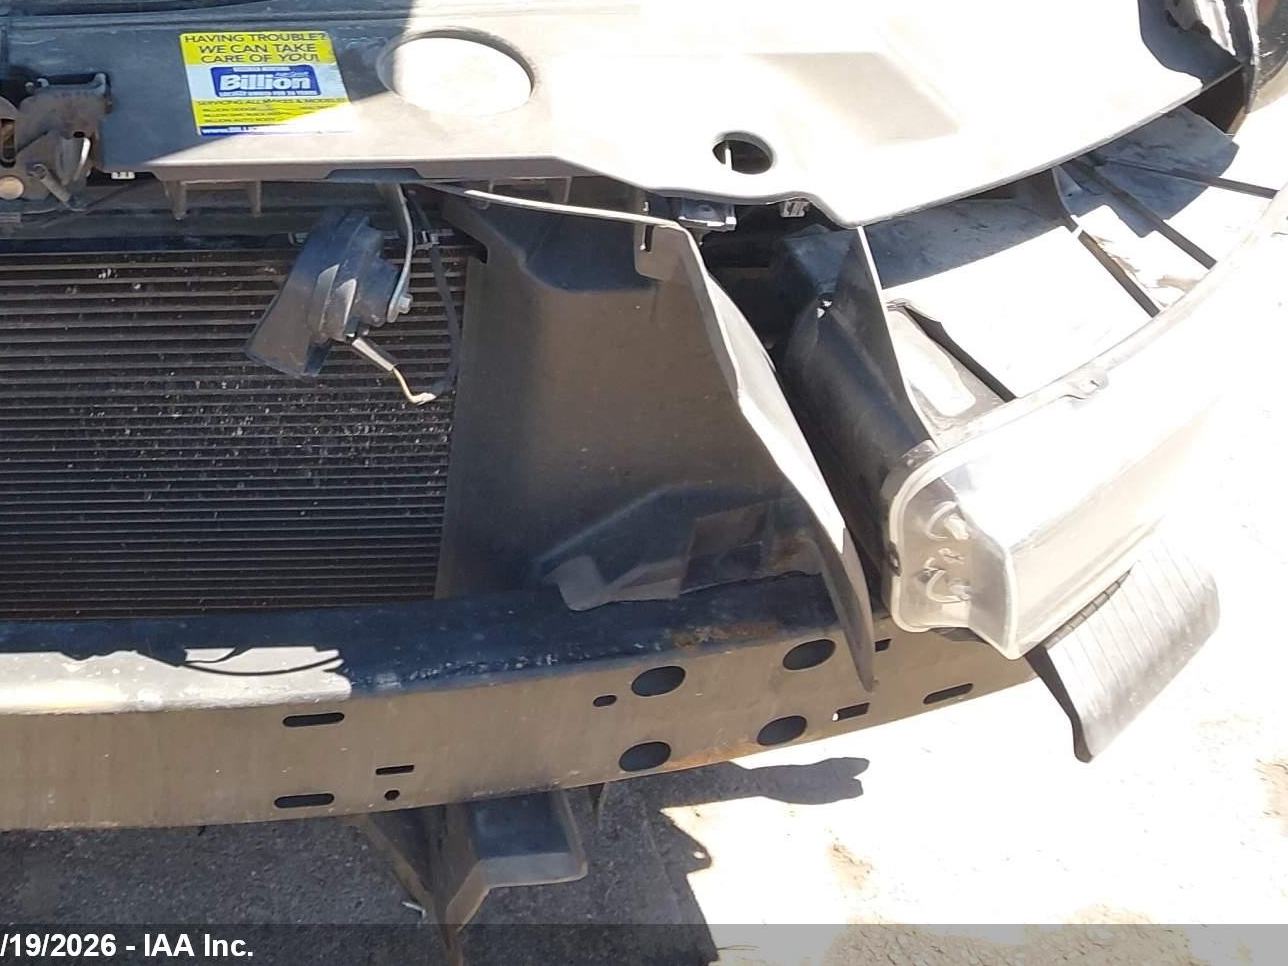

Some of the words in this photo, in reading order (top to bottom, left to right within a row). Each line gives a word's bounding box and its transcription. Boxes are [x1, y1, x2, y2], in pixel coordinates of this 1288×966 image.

[185, 34, 245, 43] HAVING
[249, 33, 327, 42] TROUBLE?
[199, 44, 225, 53] WE
[230, 44, 267, 53] CAN
[273, 43, 317, 52] TAKE
[201, 54, 244, 63] CARE
[249, 54, 272, 63] OF
[278, 53, 320, 62] YOU!
[219, 73, 311, 91] Billion
